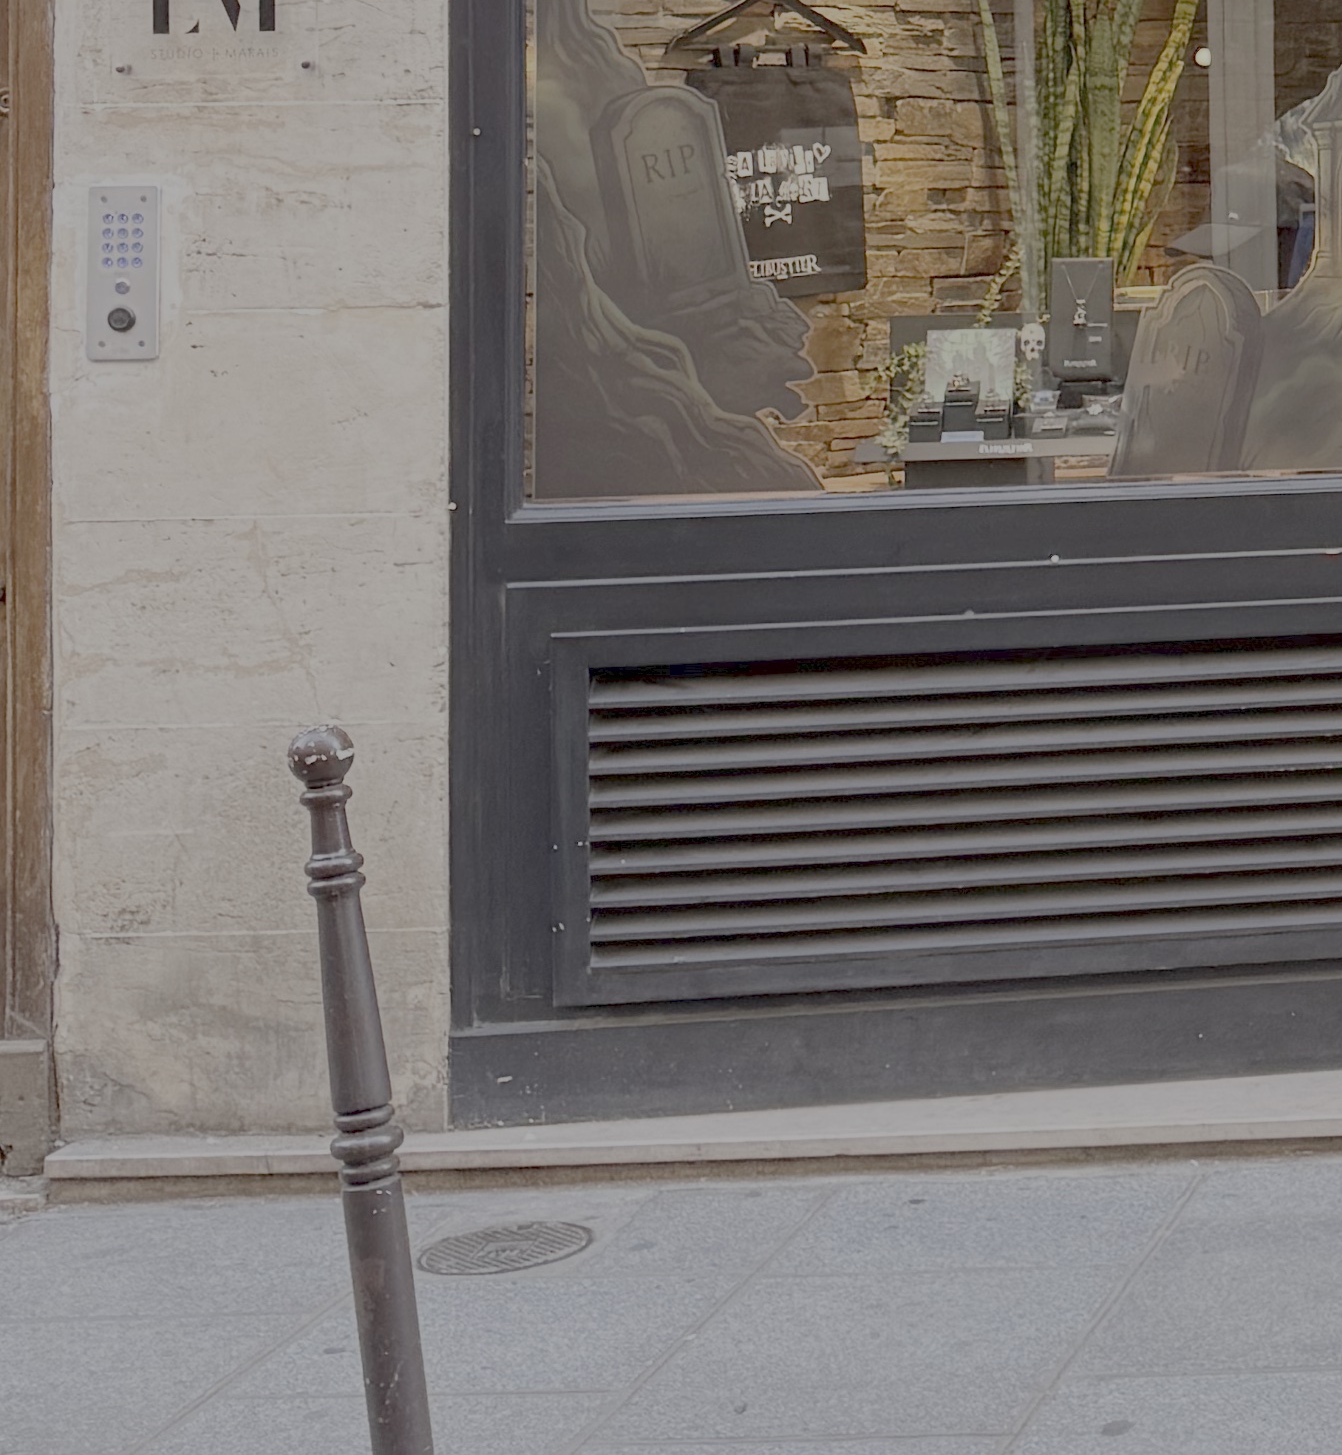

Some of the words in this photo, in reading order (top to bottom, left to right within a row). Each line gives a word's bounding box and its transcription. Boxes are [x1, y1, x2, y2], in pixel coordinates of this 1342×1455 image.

[150, 47, 204, 61] STUDIO
[224, 46, 280, 60] MARAIS
[641, 144, 696, 183] RIP
